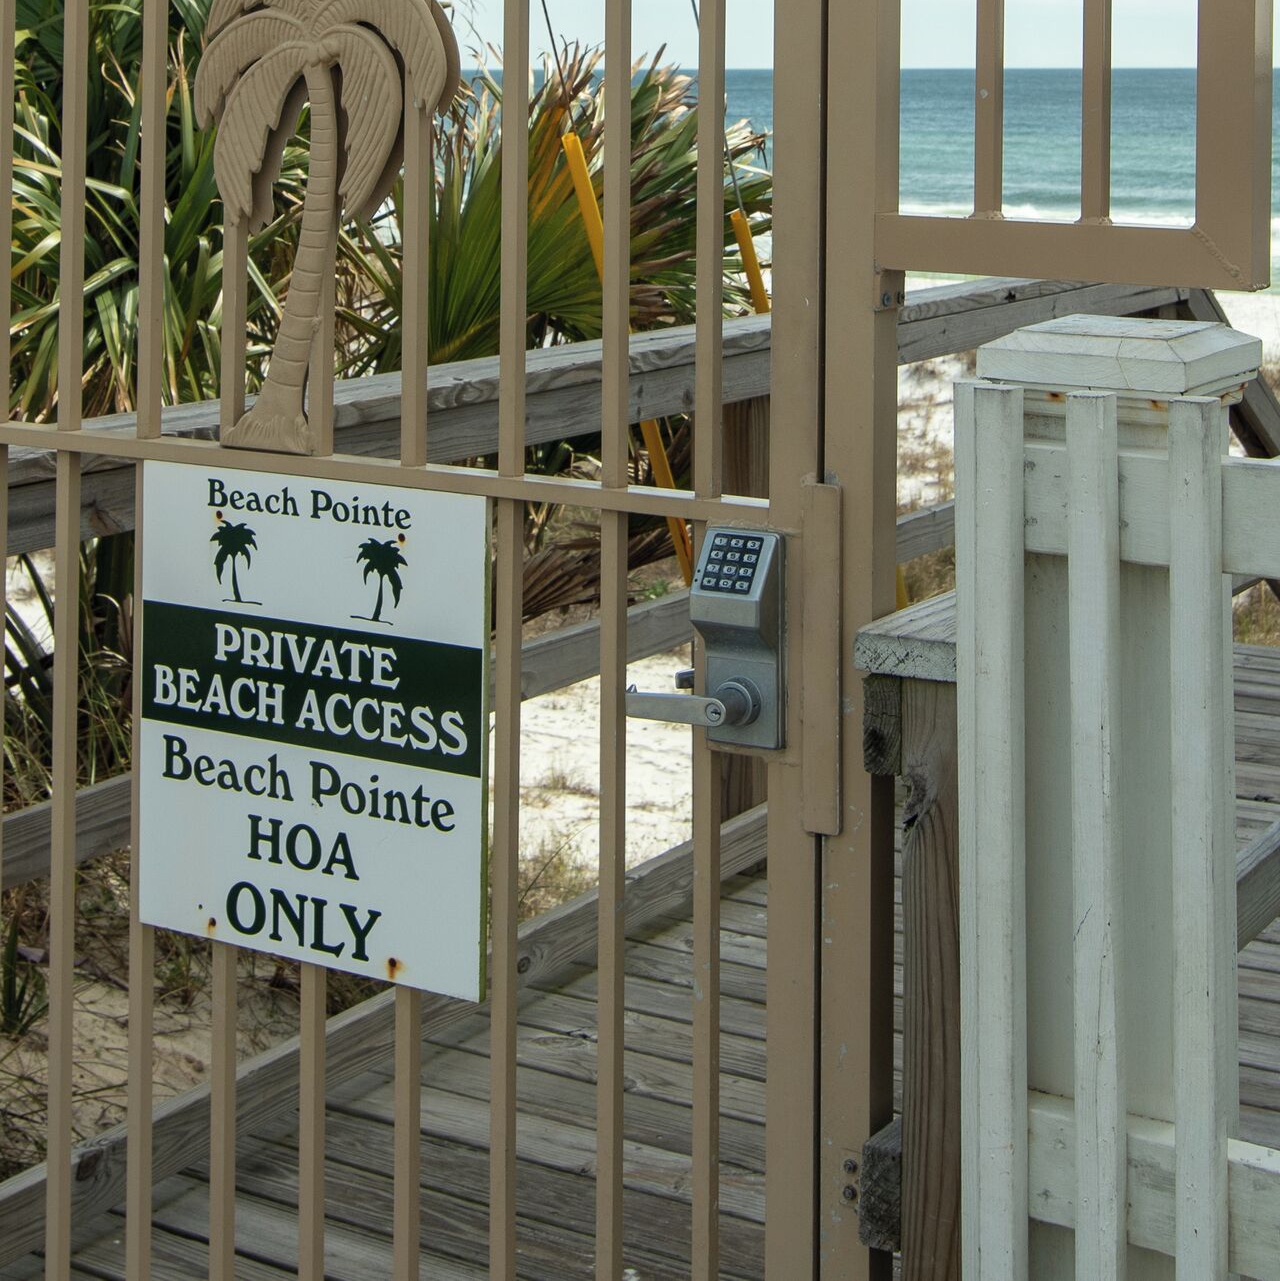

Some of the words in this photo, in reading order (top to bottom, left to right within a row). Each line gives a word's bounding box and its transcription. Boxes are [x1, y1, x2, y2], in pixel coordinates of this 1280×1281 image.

[208, 478, 300, 517] Beach
[310, 489, 412, 529] Pointe
[214, 622, 401, 690] PRIVATE
[153, 664, 285, 725] BEACH
[296, 688, 468, 756] ACCESS
[162, 734, 294, 802] Beach
[308, 760, 456, 832] Pointe
[247, 814, 360, 881] HOA
[226, 881, 382, 962] ONLY
